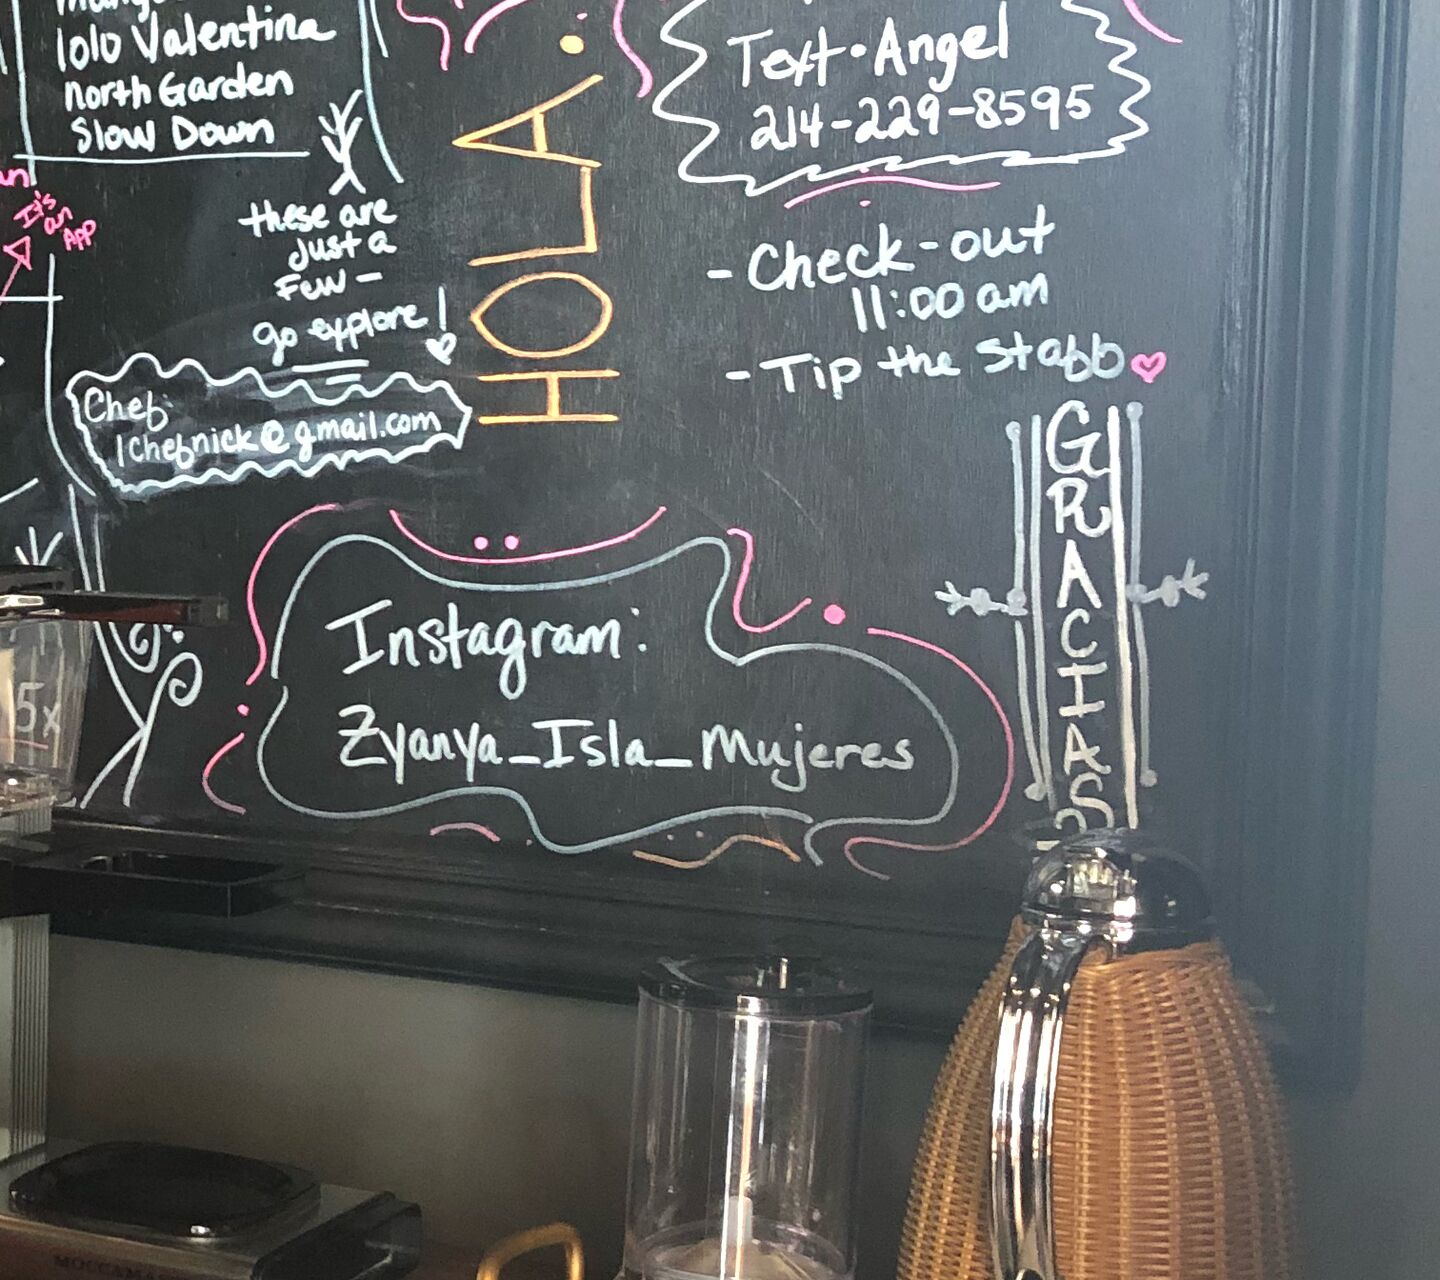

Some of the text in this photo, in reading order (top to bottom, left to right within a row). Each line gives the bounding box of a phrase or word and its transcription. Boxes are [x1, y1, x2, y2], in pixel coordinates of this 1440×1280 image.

[132, 4, 336, 63] Valentina
[160, 61, 294, 109] Garden
[71, 115, 274, 154] Slow Down
[749, 83, 1095, 152] 214-229-8595
[339, 198, 398, 227] are
[367, 230, 398, 256] a
[850, 271, 1049, 333] 11:00 am
[252, 321, 299, 367] go
[759, 352, 861, 399] Tip
[876, 343, 960, 380] the
[1046, 399, 1115, 829] GRACIAS
[325, 599, 647, 699] Instagram:
